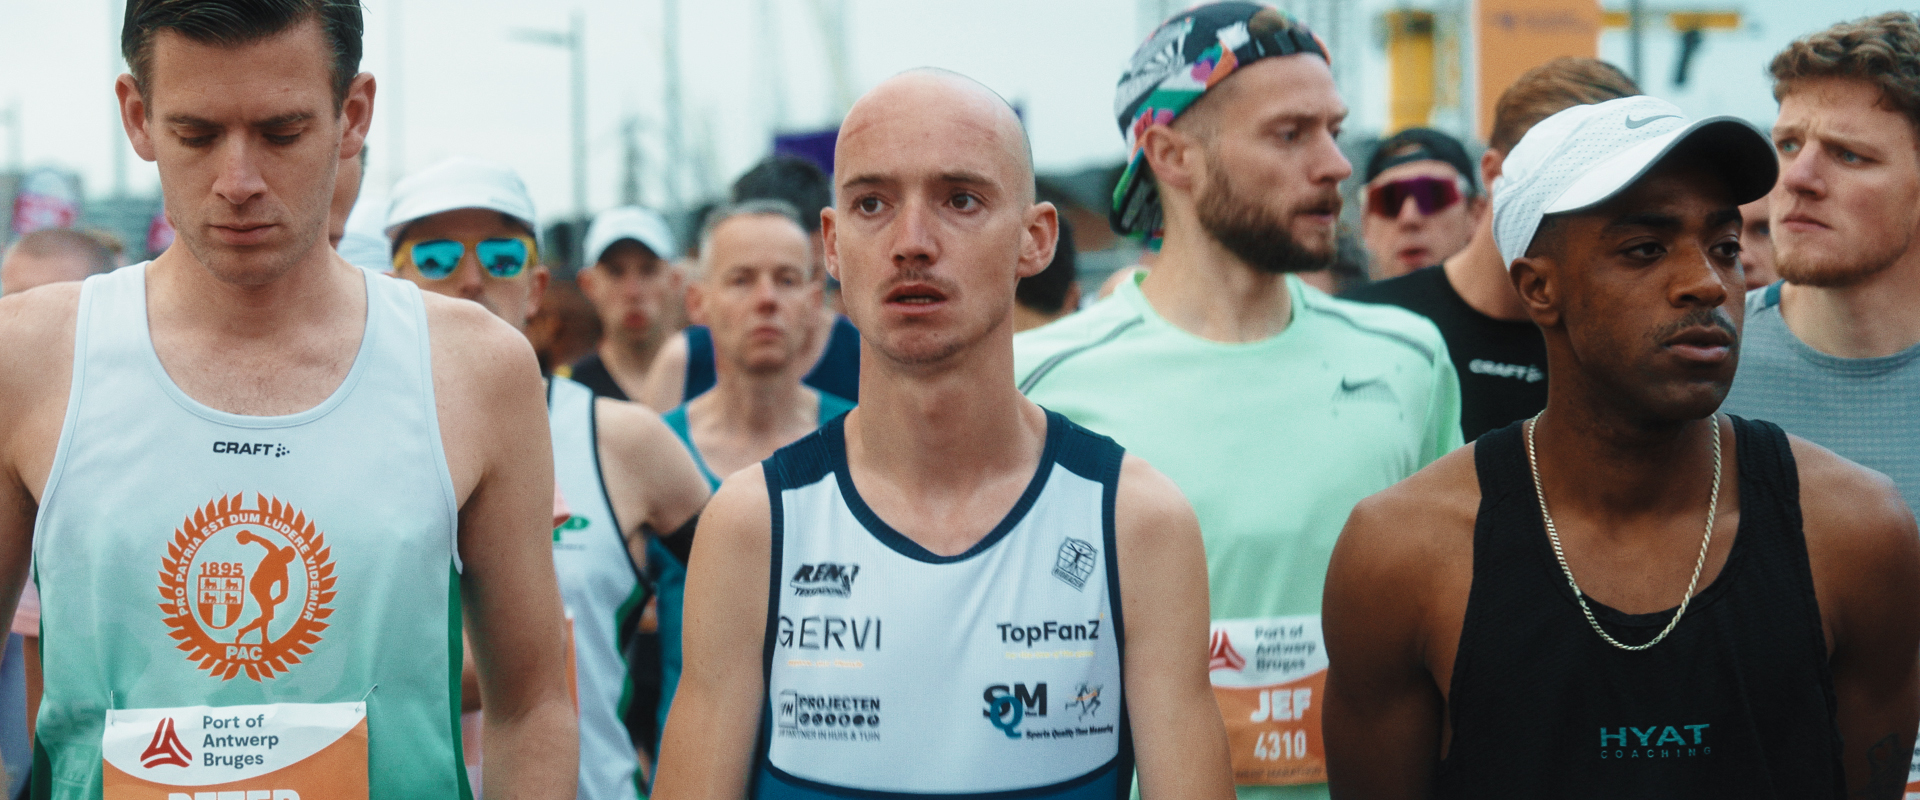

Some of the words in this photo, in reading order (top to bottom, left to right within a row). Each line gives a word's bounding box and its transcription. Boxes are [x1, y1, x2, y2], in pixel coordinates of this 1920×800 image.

[213, 441, 273, 455] CRAFT
[229, 513, 260, 524] DUM
[203, 517, 225, 537] EST
[264, 516, 310, 554] LUDERE
[176, 537, 202, 583] PATRIA
[200, 562, 243, 575] 1895
[303, 556, 320, 621] VIDEMUR
[174, 587, 189, 616] PRO
[778, 615, 881, 651] GERVI
[996, 620, 1100, 648] TopFanZ
[1255, 624, 1285, 639] Port
[1290, 624, 1303, 638] of
[226, 645, 262, 661] PAC
[1256, 641, 1316, 656] Antwerp
[1256, 658, 1306, 673] Bruges
[799, 696, 880, 711] PROJECTEN
[1250, 688, 1312, 723] JEF
[203, 715, 240, 729] Port
[246, 714, 265, 728] of
[202, 733, 279, 749] Antwerp
[1600, 724, 1710, 747] HYAT
[1254, 729, 1306, 761] 4310
[1600, 747, 1711, 759] COACHING
[203, 752, 264, 769] Bruges
